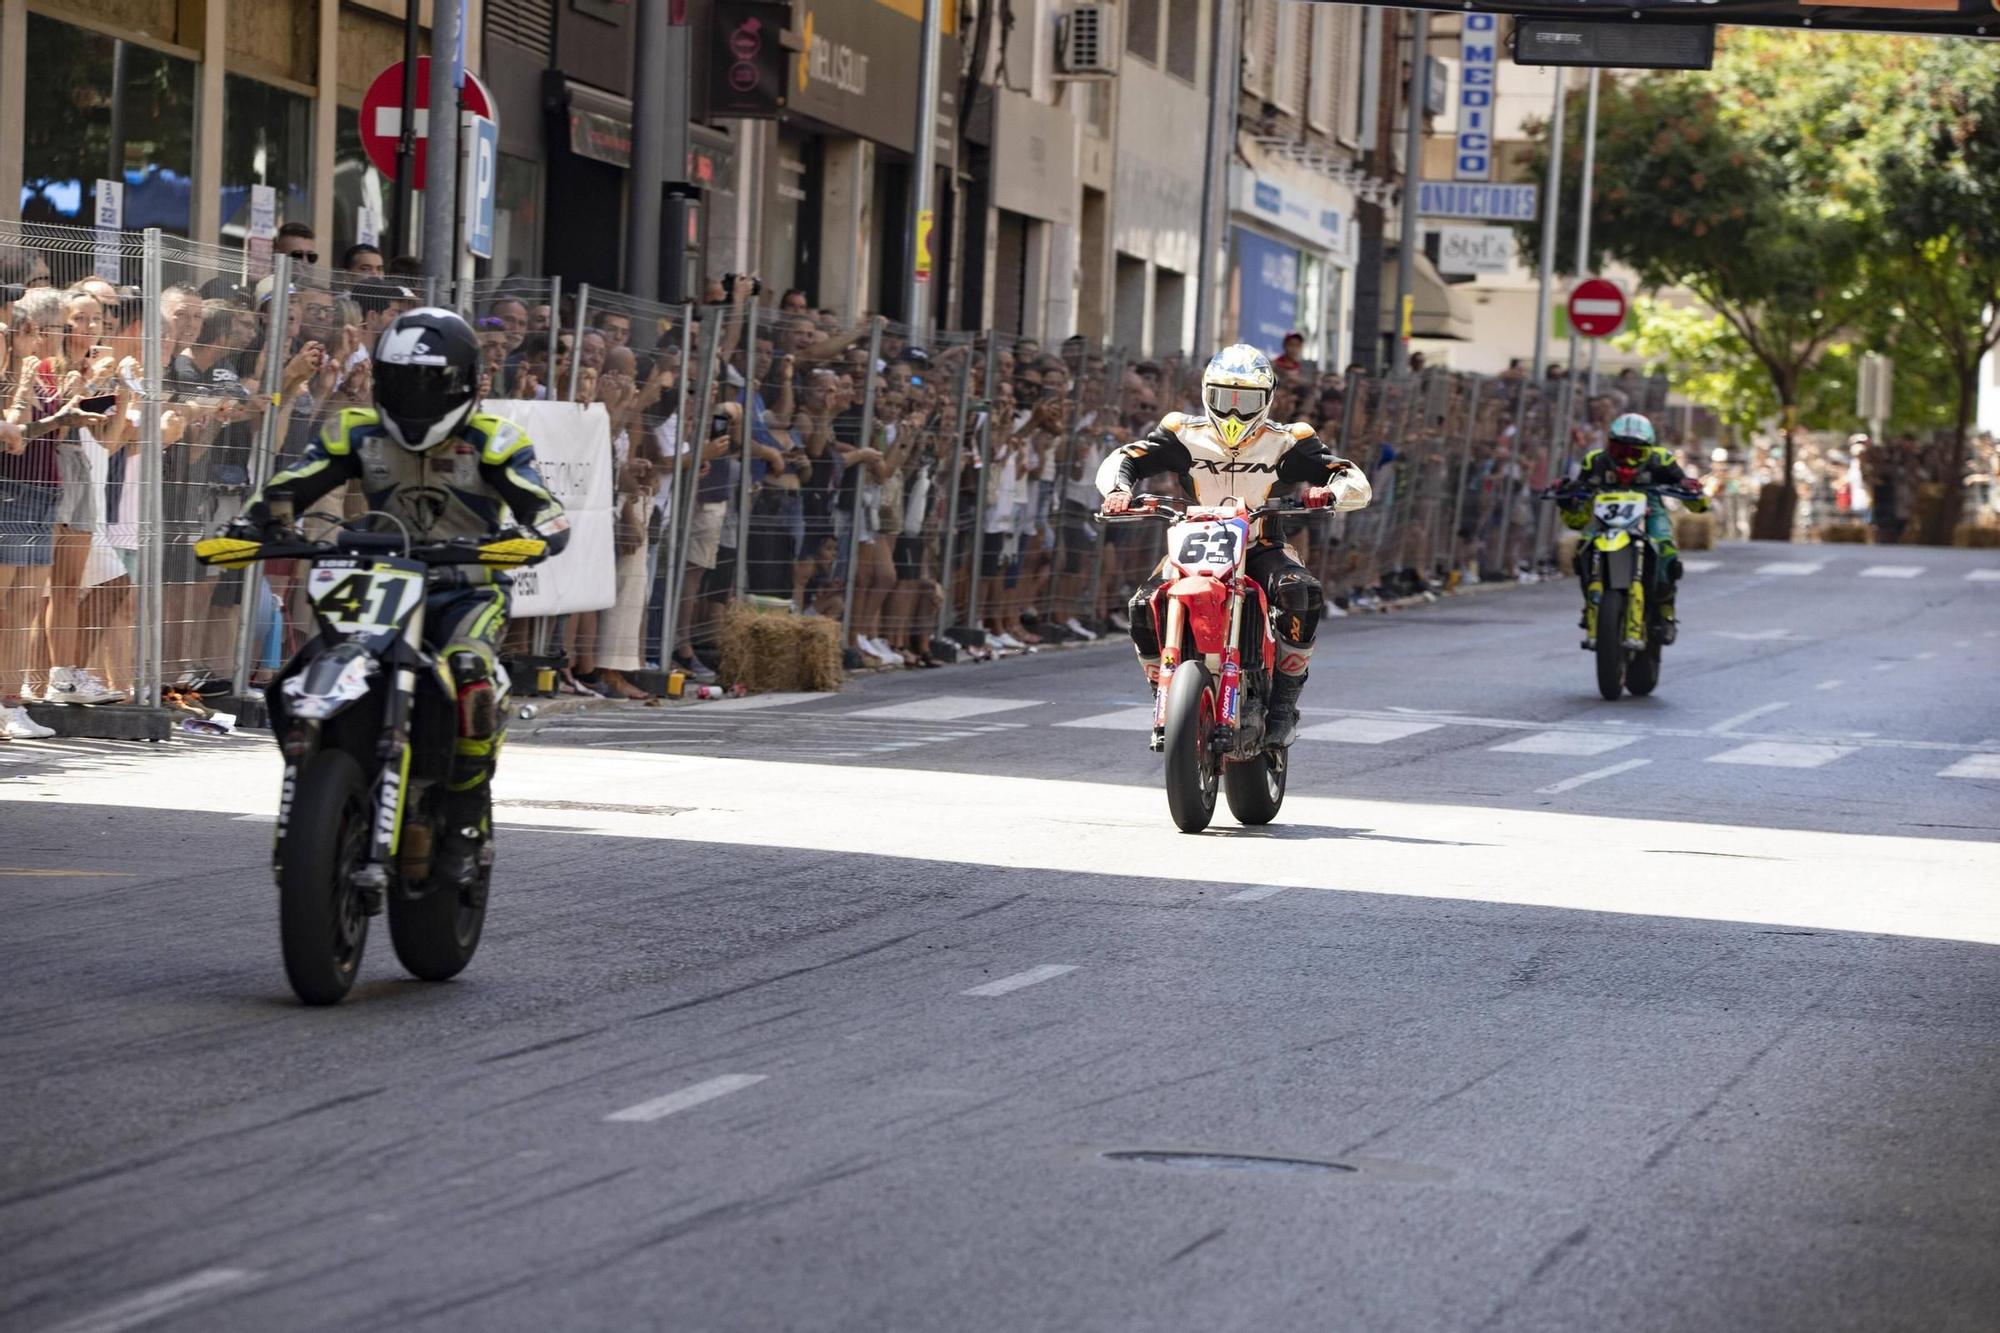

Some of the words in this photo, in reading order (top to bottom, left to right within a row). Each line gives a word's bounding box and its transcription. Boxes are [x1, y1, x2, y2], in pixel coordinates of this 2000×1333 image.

[1459, 46, 1492, 172] MEDICO
[478, 137, 492, 199] P
[1420, 184, 1534, 216] ONDUCTORES
[1604, 504, 1635, 520] 34
[1178, 532, 1237, 564] 63
[320, 574, 408, 626] 41
